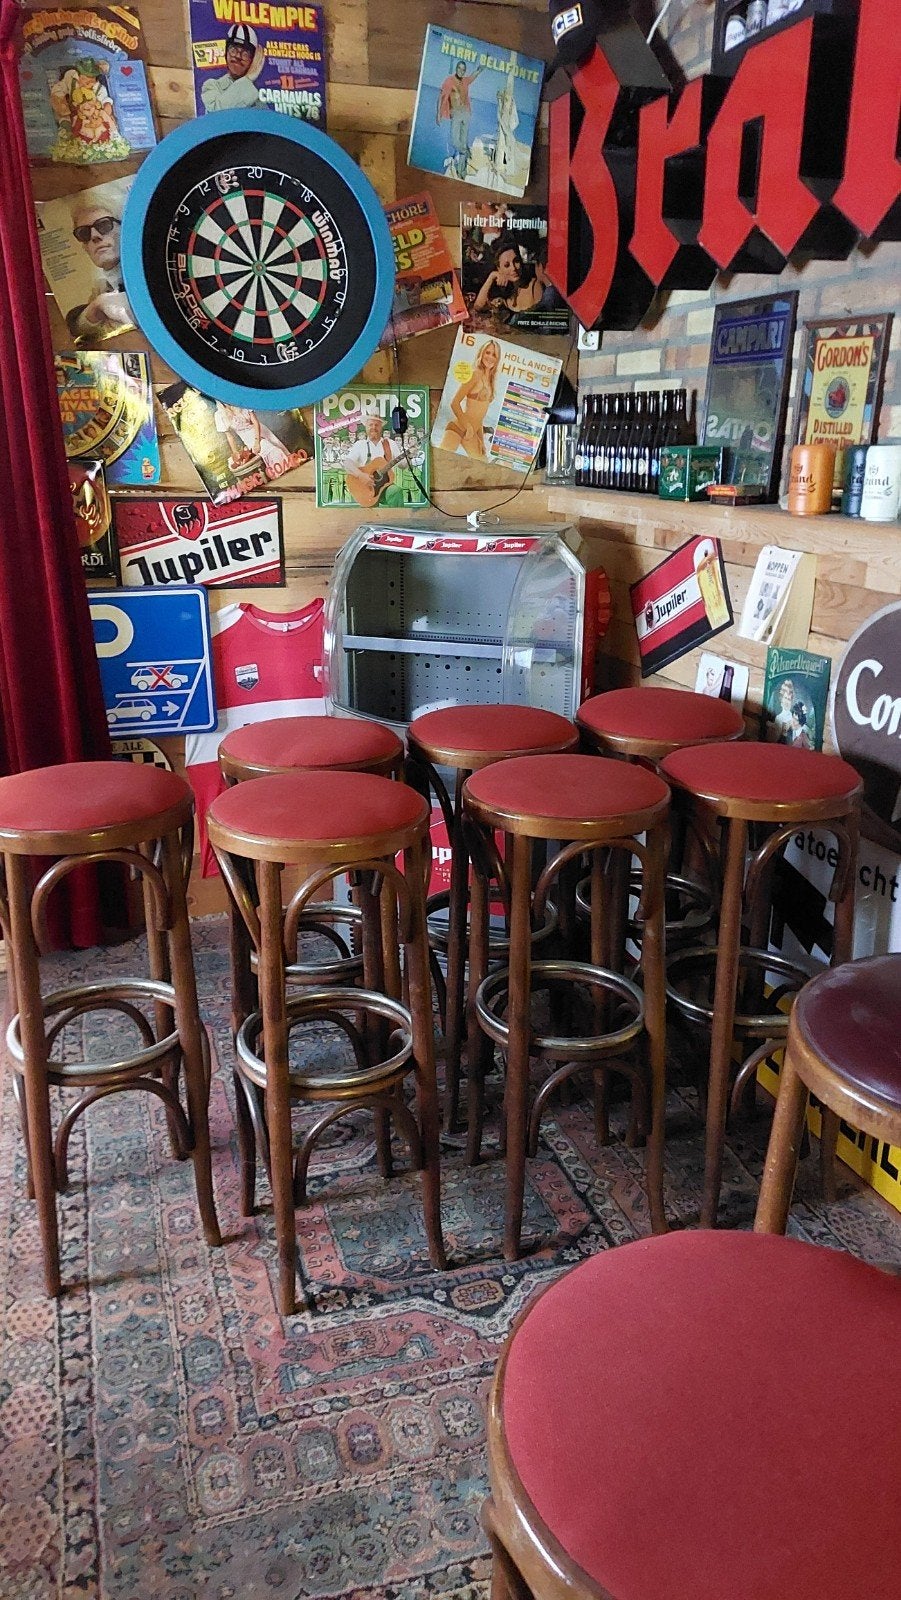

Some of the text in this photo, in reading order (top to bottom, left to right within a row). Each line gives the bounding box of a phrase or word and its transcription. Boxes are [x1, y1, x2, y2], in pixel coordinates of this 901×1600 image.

[213, 0, 318, 31] WILLEMPIE
[441, 41, 540, 84] HARRY BELAFONTE
[259, 88, 322, 108] CARNAVALS
[274, 102, 302, 118] HITS
[247, 166, 263, 178] 20
[299, 186, 313, 202] 18
[463, 214, 472, 227] In
[474, 214, 488, 227] der
[489, 215, 505, 228] Bar
[460, 333, 476, 347] 16
[718, 320, 785, 355] CAMPARI
[233, 347, 245, 361] 19
[817, 341, 870, 372] GORDON'S
[504, 352, 559, 376] HOLLANDSE
[501, 363, 552, 389] HITS 5
[813, 419, 853, 435] DISTILLED
[385, 535, 404, 543] Jupiler
[126, 530, 273, 586] Jupiler
[654, 589, 687, 624] Jupiler
[122, 741, 144, 751] ALE
